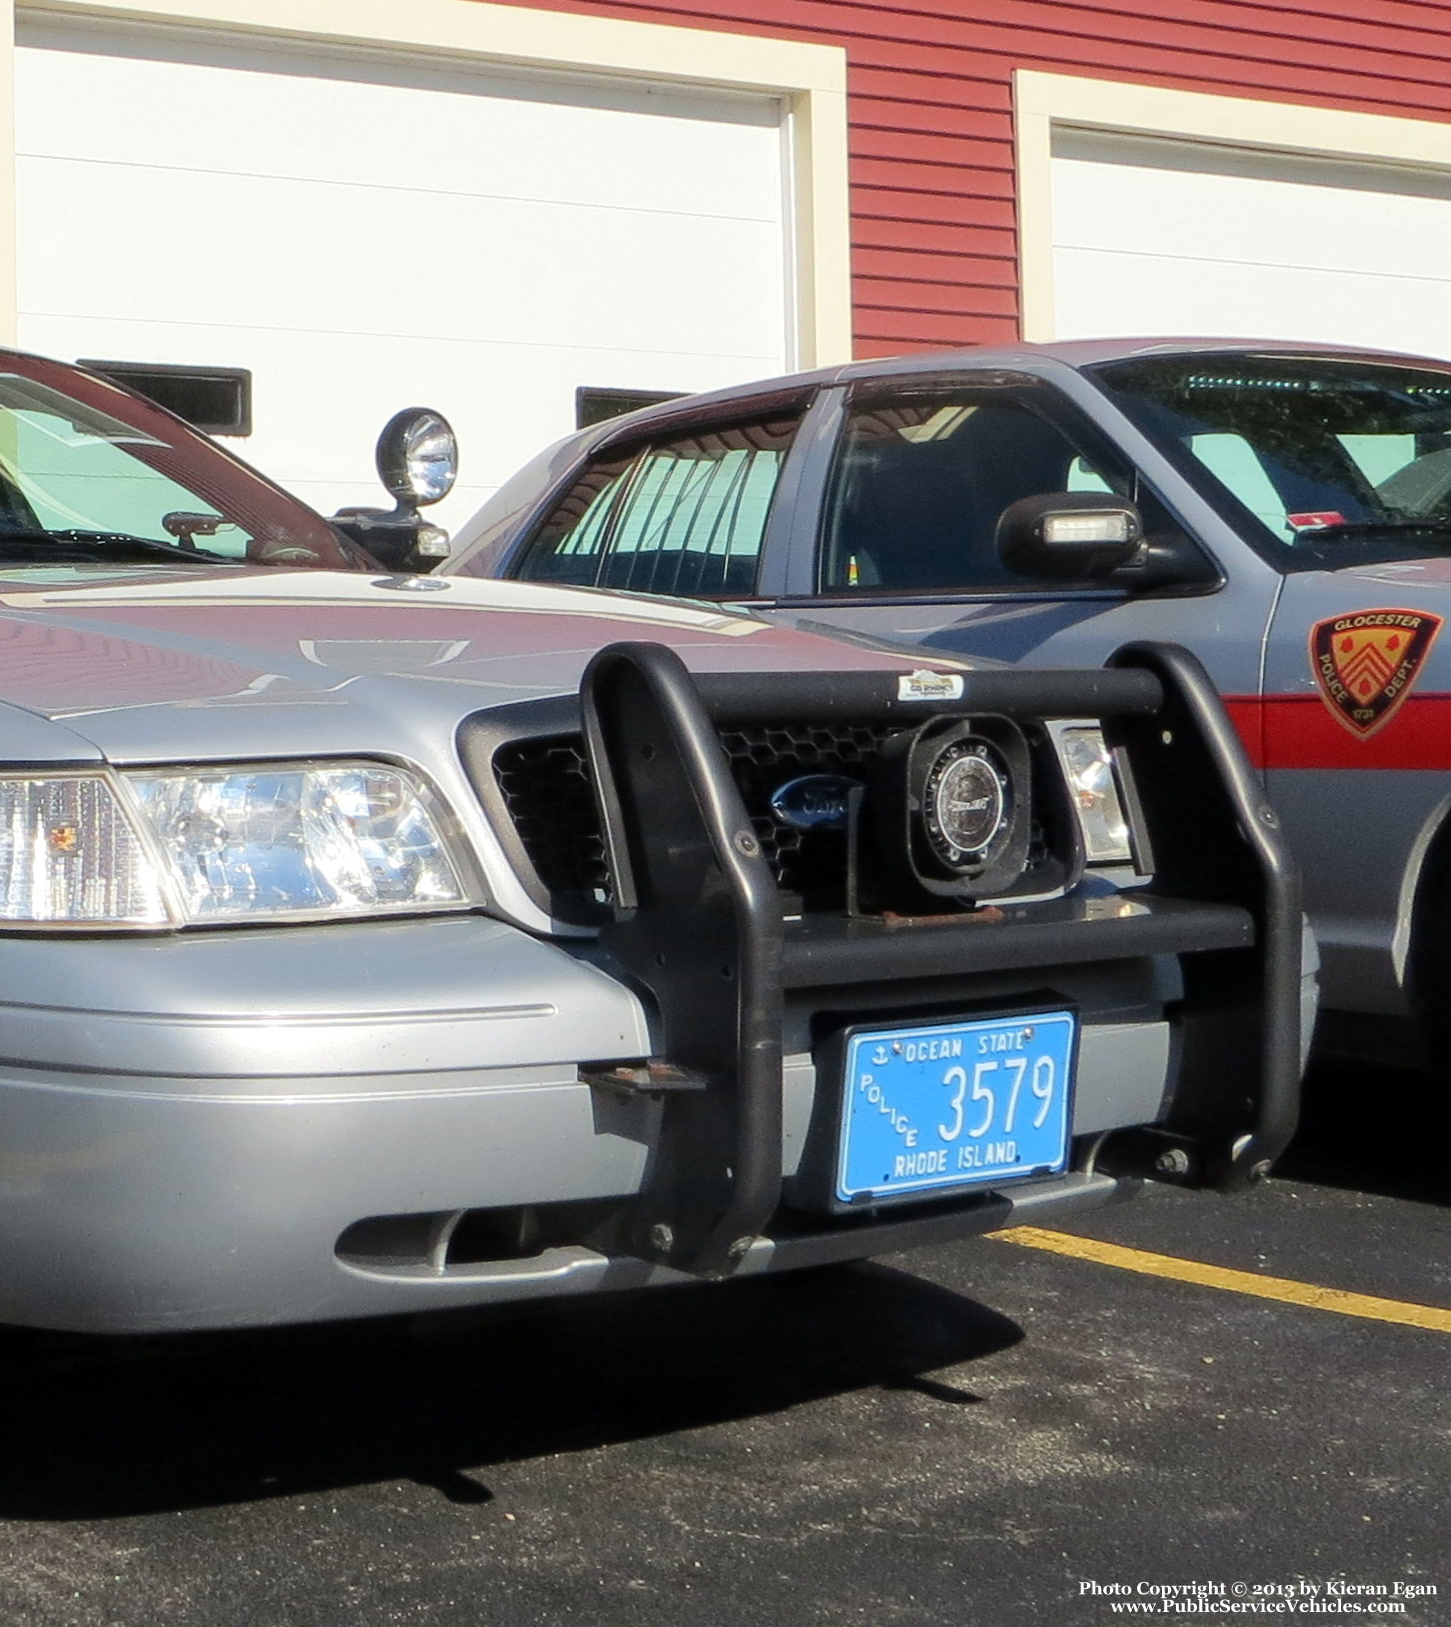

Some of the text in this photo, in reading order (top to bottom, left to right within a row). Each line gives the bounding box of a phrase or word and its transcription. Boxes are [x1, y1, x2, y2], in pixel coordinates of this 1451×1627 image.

[1334, 614, 1422, 631] GLOCESTER
[1319, 654, 1348, 703] POLICE
[1384, 658, 1418, 698] DEPT.
[1353, 709, 1375, 719] 1731
[905, 1031, 1024, 1062] OCEAN STATE
[859, 1074, 919, 1147] POLICE
[938, 1055, 1056, 1141] 3579
[894, 1140, 1017, 1178] RHODE ISLAND
